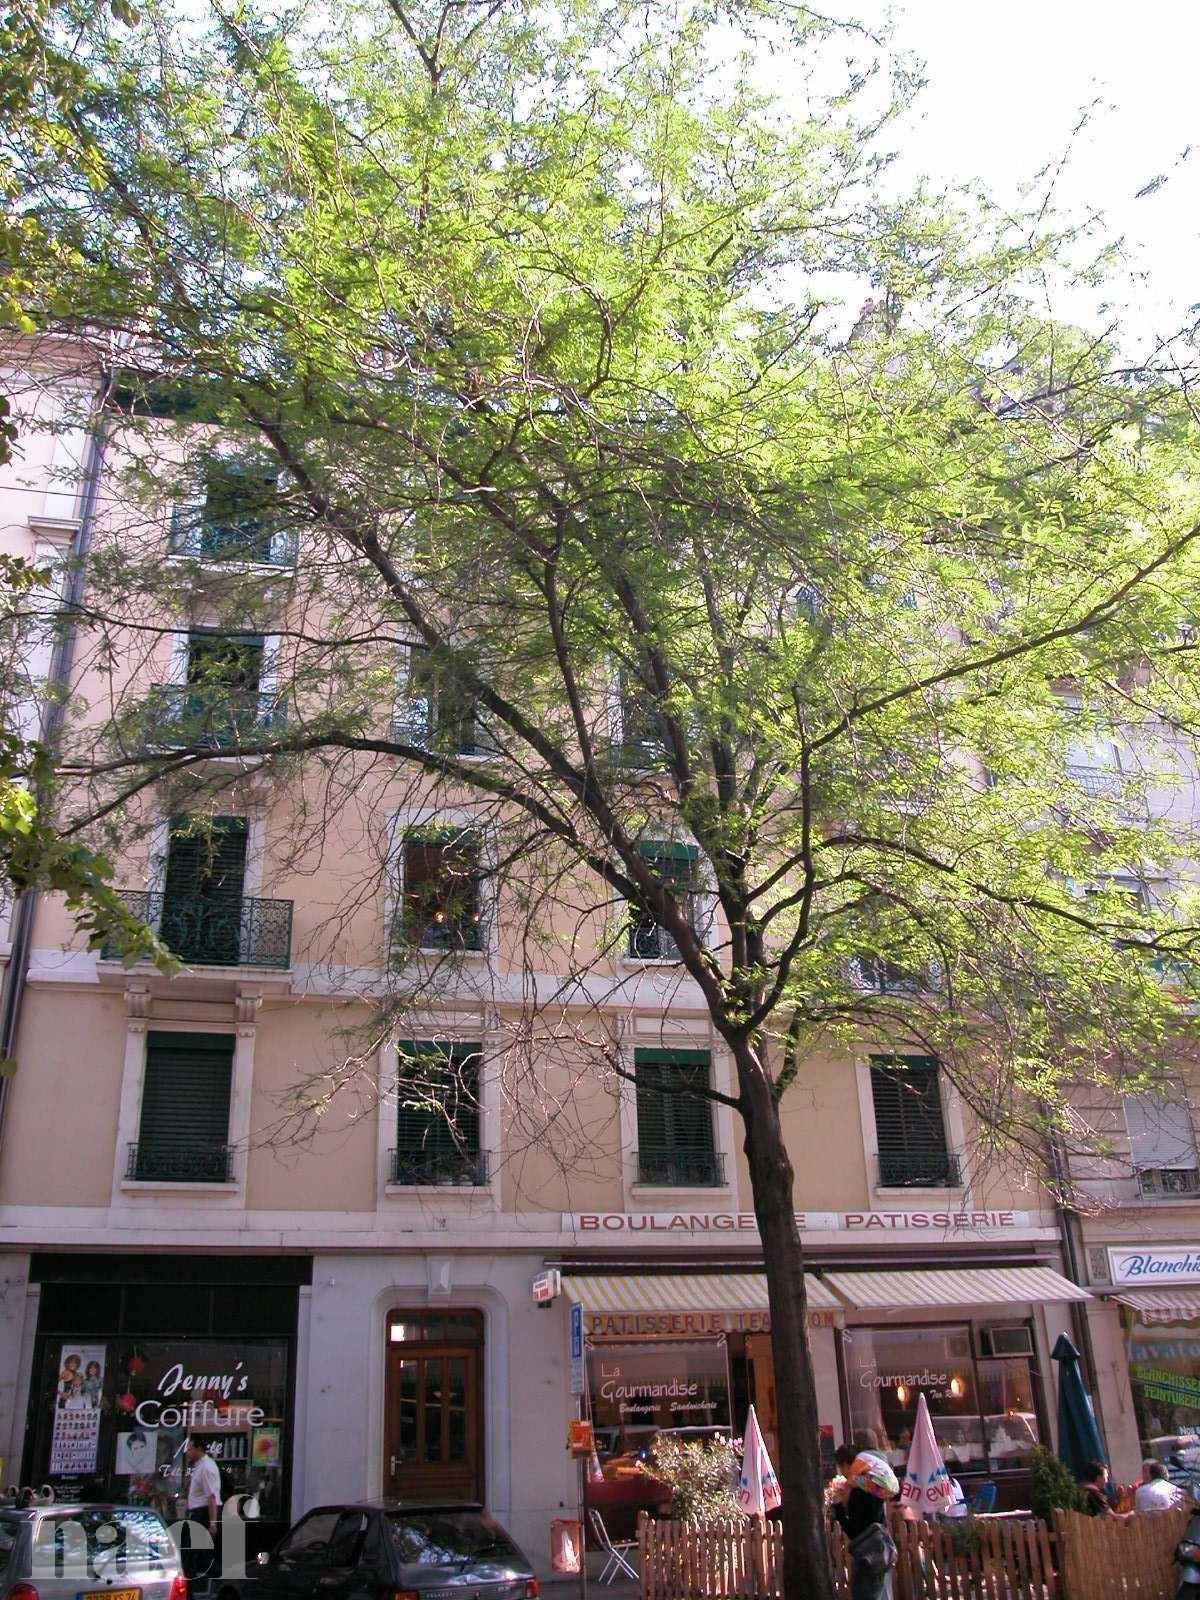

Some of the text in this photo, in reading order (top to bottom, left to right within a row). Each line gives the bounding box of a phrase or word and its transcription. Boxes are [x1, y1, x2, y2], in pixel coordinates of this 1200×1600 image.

[579, 1213, 806, 1230] BOULANGEE
[845, 1211, 1015, 1229] PATISSERIE
[592, 1314, 721, 1332] PATISSERIE
[736, 1312, 771, 1330] TEA
[601, 1361, 620, 1377] La
[860, 1368, 947, 1392] Gourmandise
[157, 1362, 249, 1399] Jenny's
[600, 1377, 698, 1403] Gourmandise
[135, 1399, 265, 1428] Coiffure
